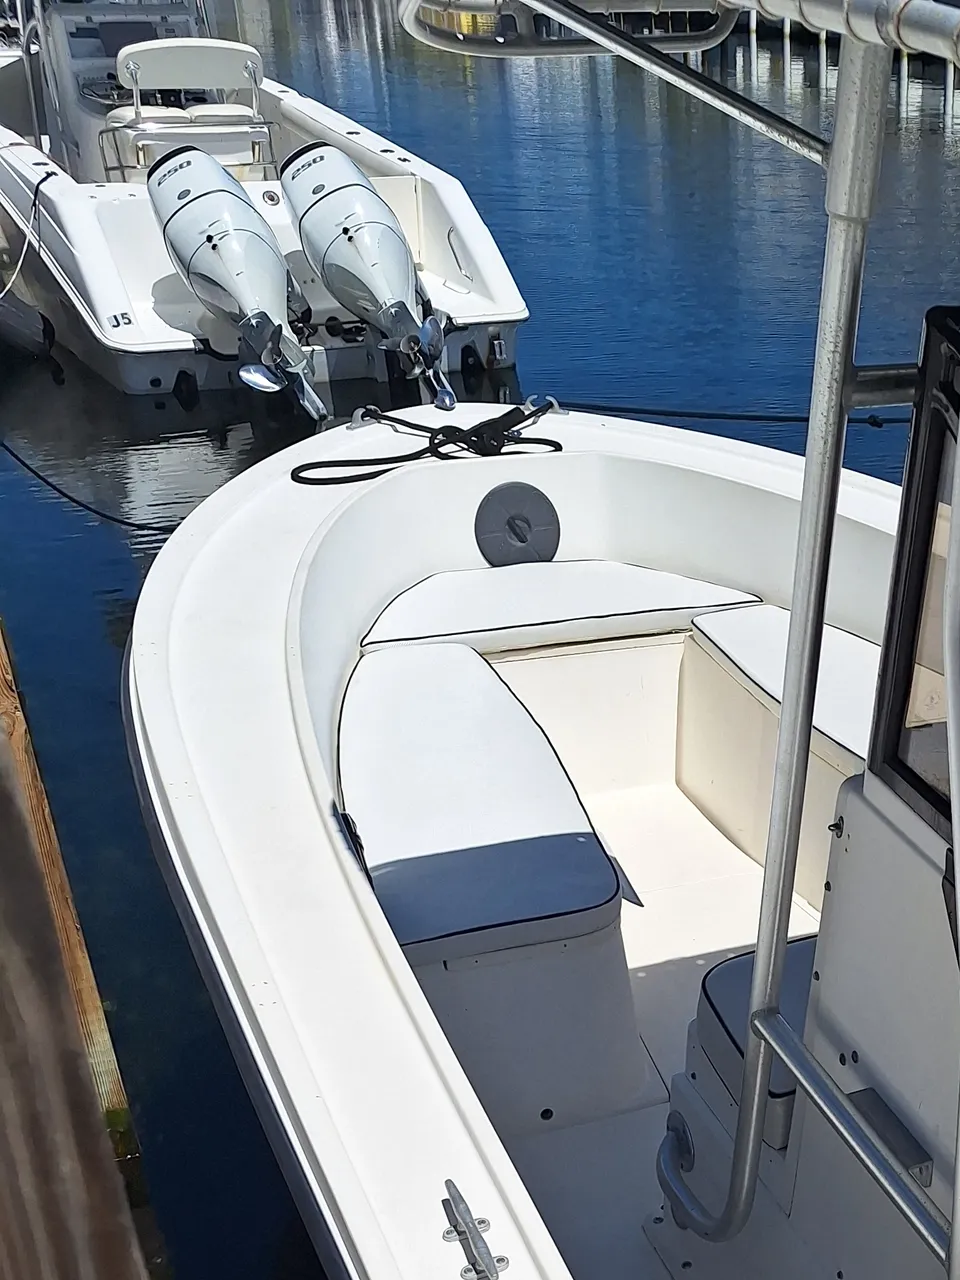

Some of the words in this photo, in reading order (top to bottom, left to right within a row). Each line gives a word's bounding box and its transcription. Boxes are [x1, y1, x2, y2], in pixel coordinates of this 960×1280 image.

[157, 160, 192, 187] 250
[291, 155, 325, 181] 250
[111, 312, 132, 328] J5
